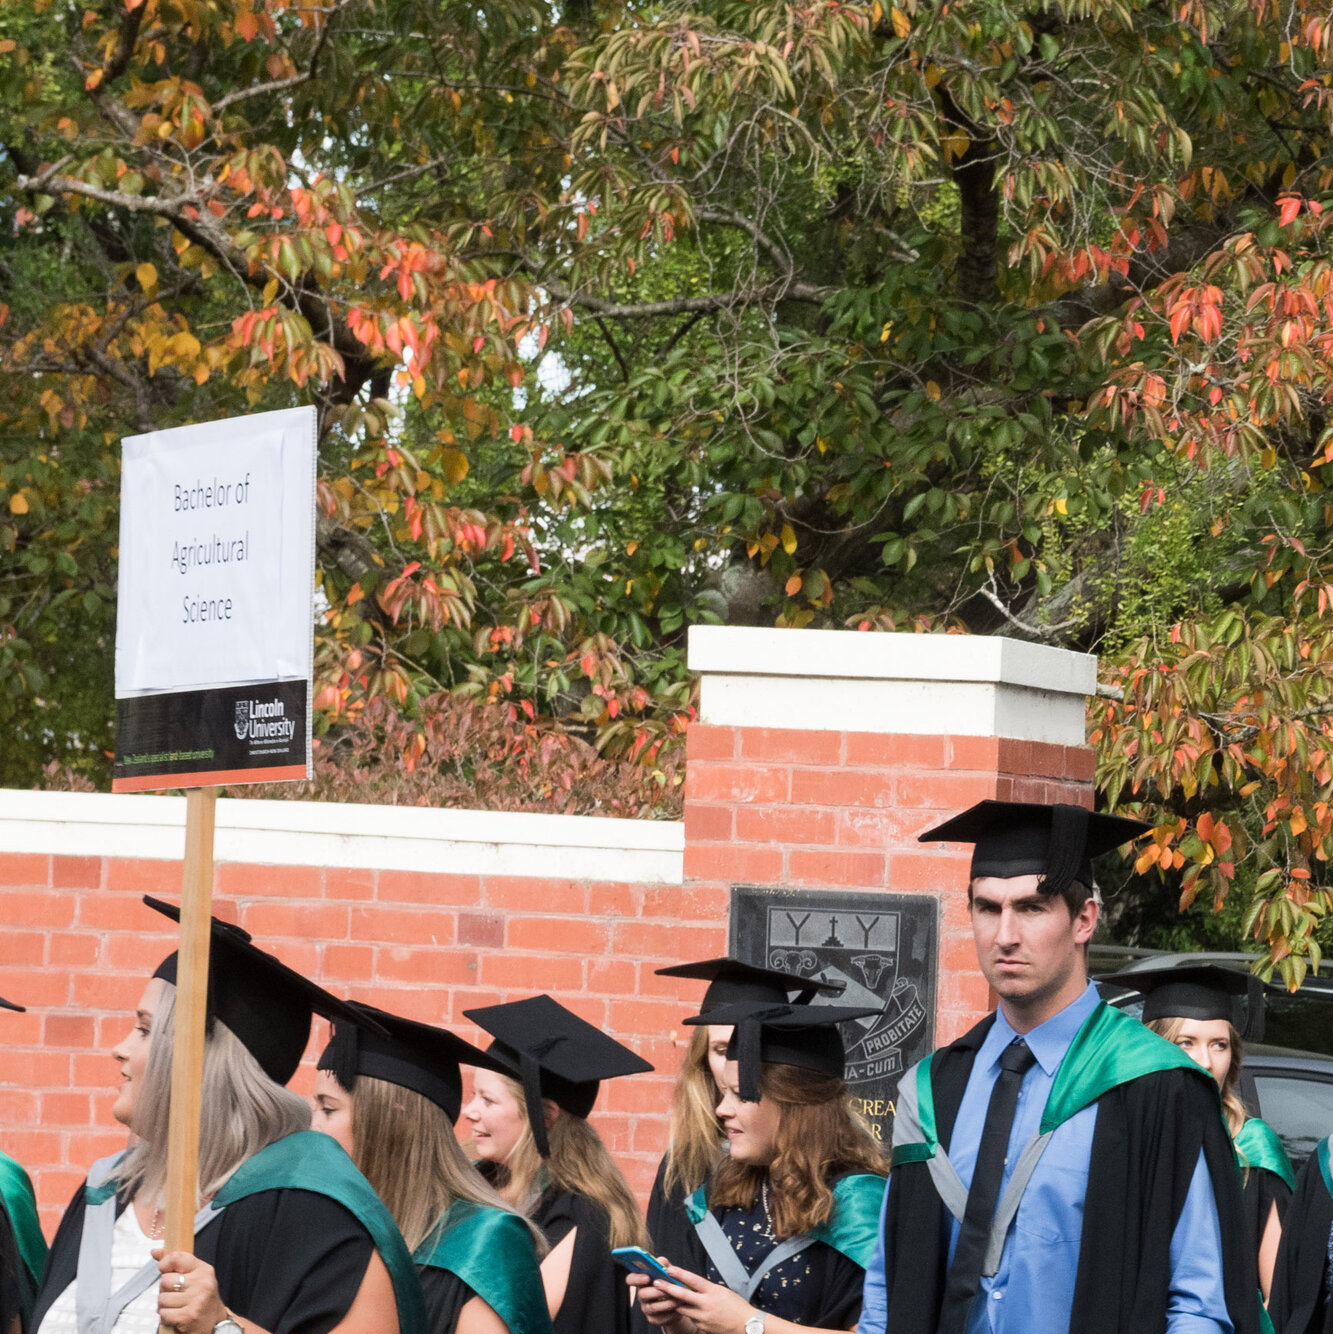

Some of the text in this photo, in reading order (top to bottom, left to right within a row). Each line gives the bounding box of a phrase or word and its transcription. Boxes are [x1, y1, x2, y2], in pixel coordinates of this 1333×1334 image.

[174, 472, 251, 512] Bachelor of
[171, 530, 249, 575] Agricultural
[182, 594, 233, 624] Science
[249, 698, 285, 719] Lincoln
[248, 717, 296, 740] University
[866, 1004, 922, 1054] PROBITATE
